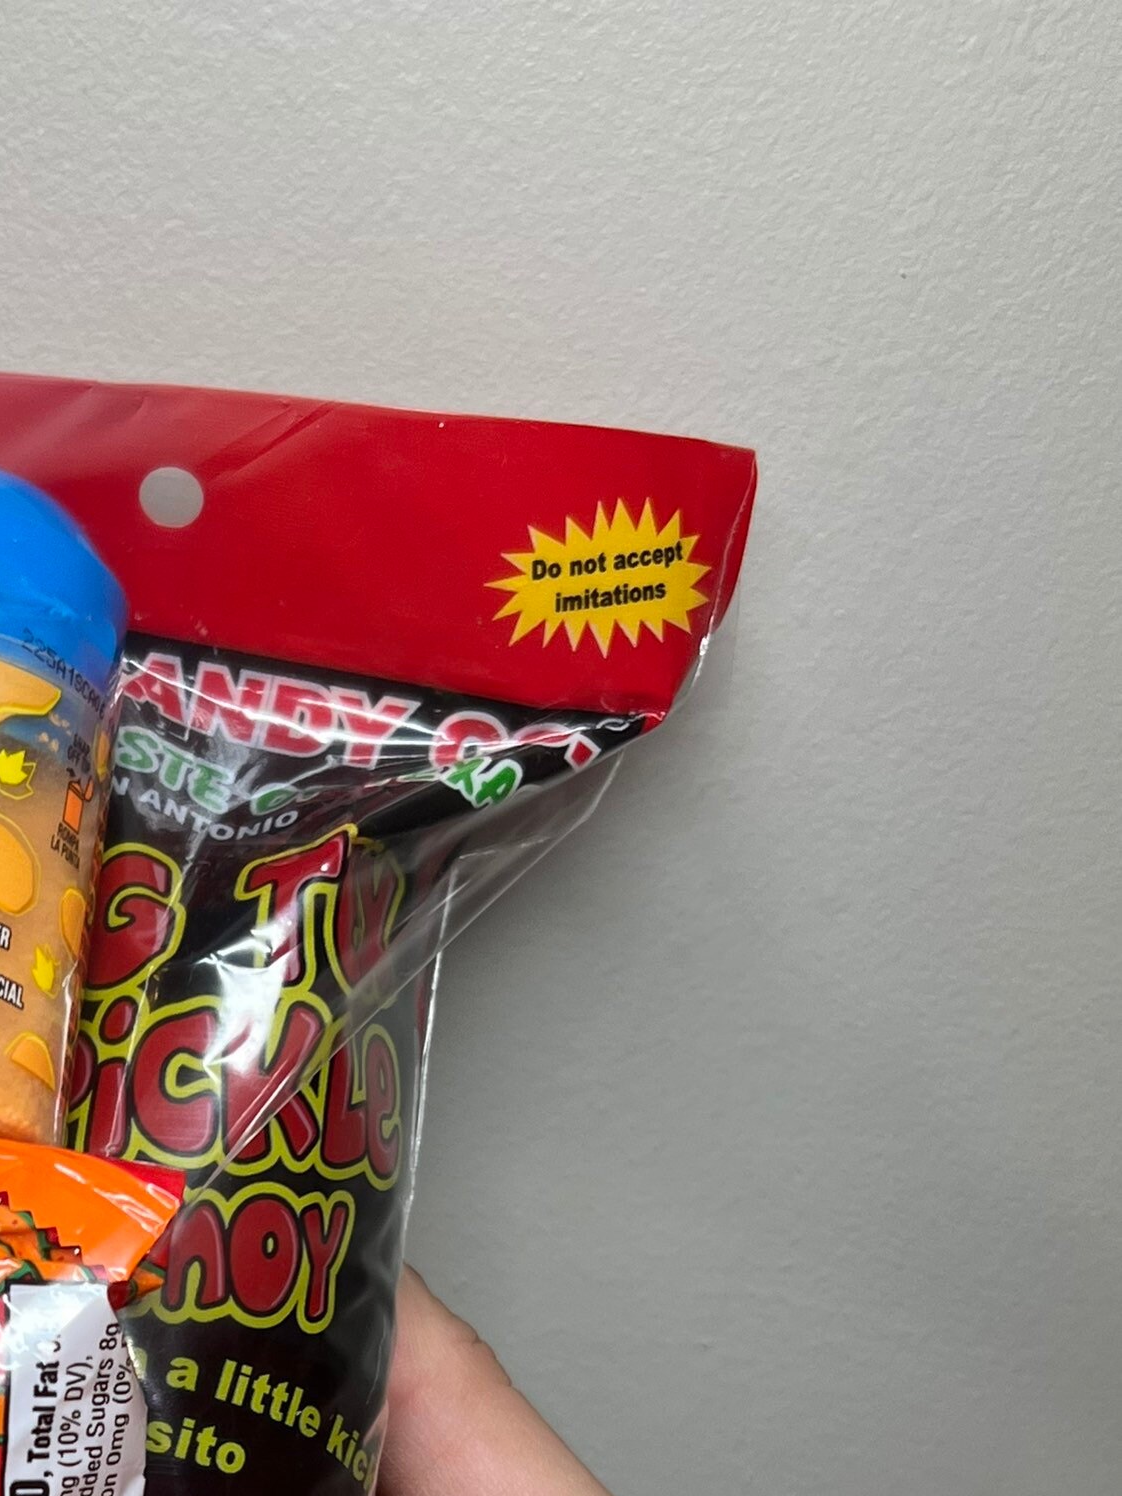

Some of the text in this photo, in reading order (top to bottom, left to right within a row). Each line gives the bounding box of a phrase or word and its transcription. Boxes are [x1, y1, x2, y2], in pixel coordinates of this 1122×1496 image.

[532, 541, 683, 580] Do not accept
[555, 582, 666, 613] imitations
[125, 652, 421, 767] ANDY
[139, 788, 299, 842] ANTONIO
[33, 1360, 60, 1398] Fat
[64, 1356, 93, 1401] DV),
[86, 1358, 115, 1438] Sugars
[165, 1357, 199, 1391] a
[214, 1358, 321, 1438] little
[27, 1406, 56, 1463] Total
[57, 1410, 81, 1467] (10%
[106, 1414, 130, 1466] 0mg
[145, 1416, 246, 1475] sito
